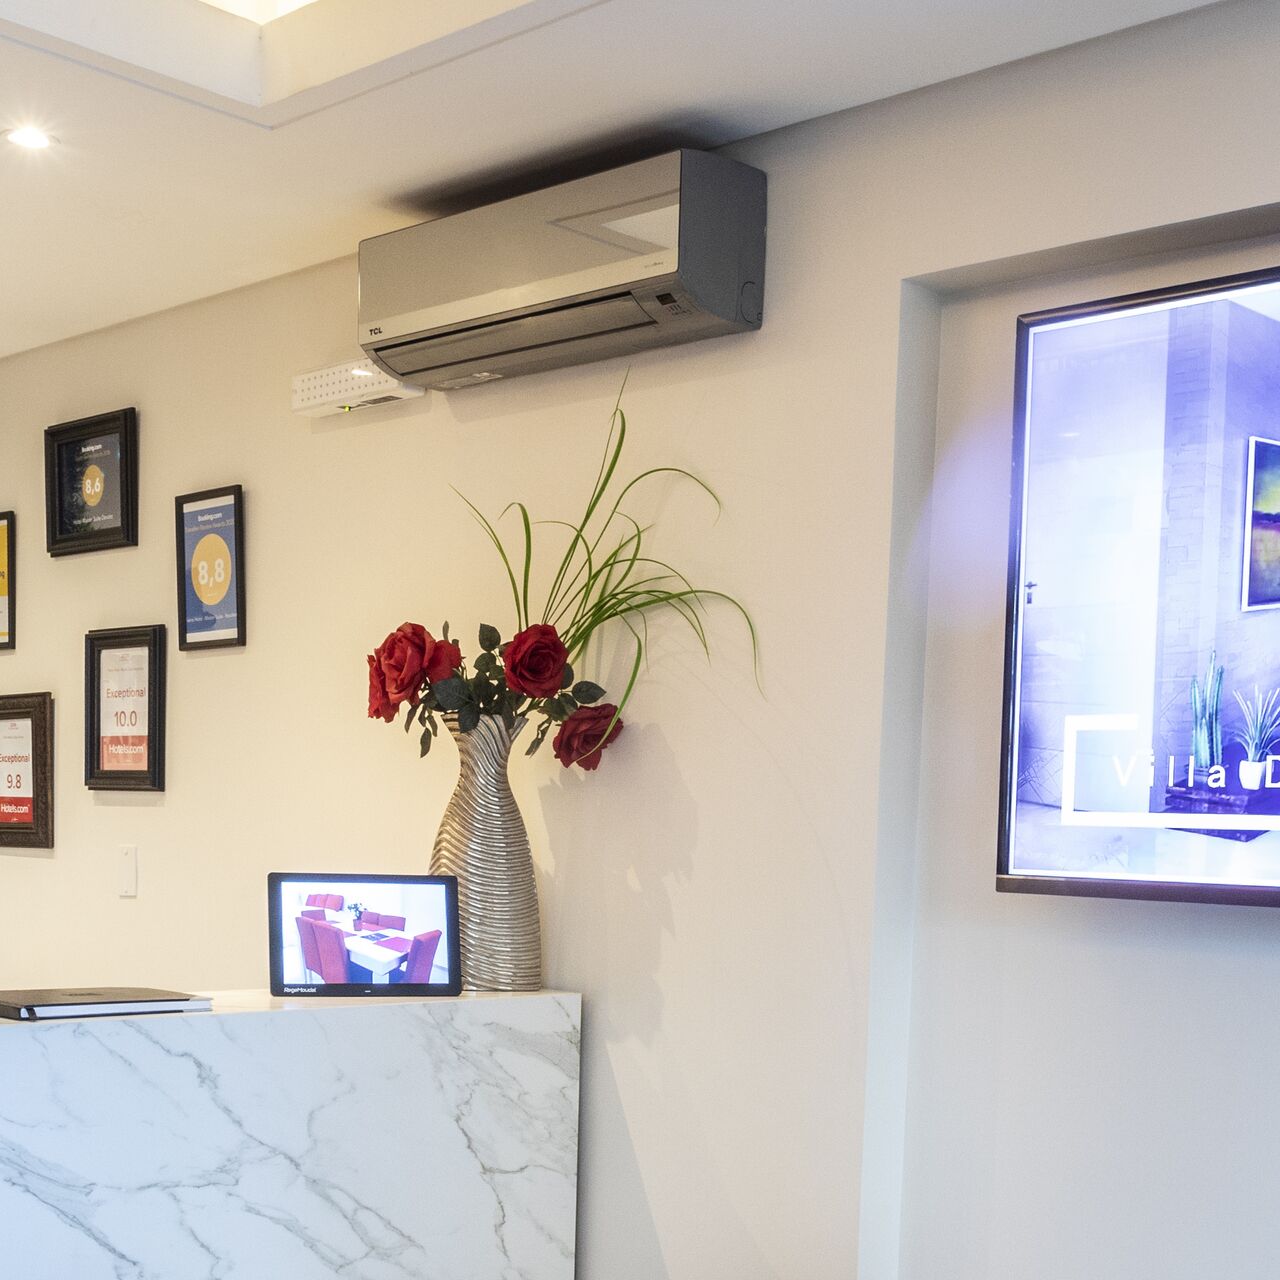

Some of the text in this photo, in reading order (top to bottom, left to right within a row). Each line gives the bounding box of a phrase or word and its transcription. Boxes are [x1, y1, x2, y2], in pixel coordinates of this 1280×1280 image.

[369, 327, 383, 336] TCL
[85, 477, 101, 496] 8,6
[198, 558, 225, 588] 8,8
[106, 687, 147, 699] Exceptional
[114, 710, 138, 727] 10.0
[108, 743, 145, 755] Hotels.com
[1113, 754, 1227, 788] Villa
[6, 774, 22, 789] 9.8
[0, 803, 30, 814] Hotels.com
